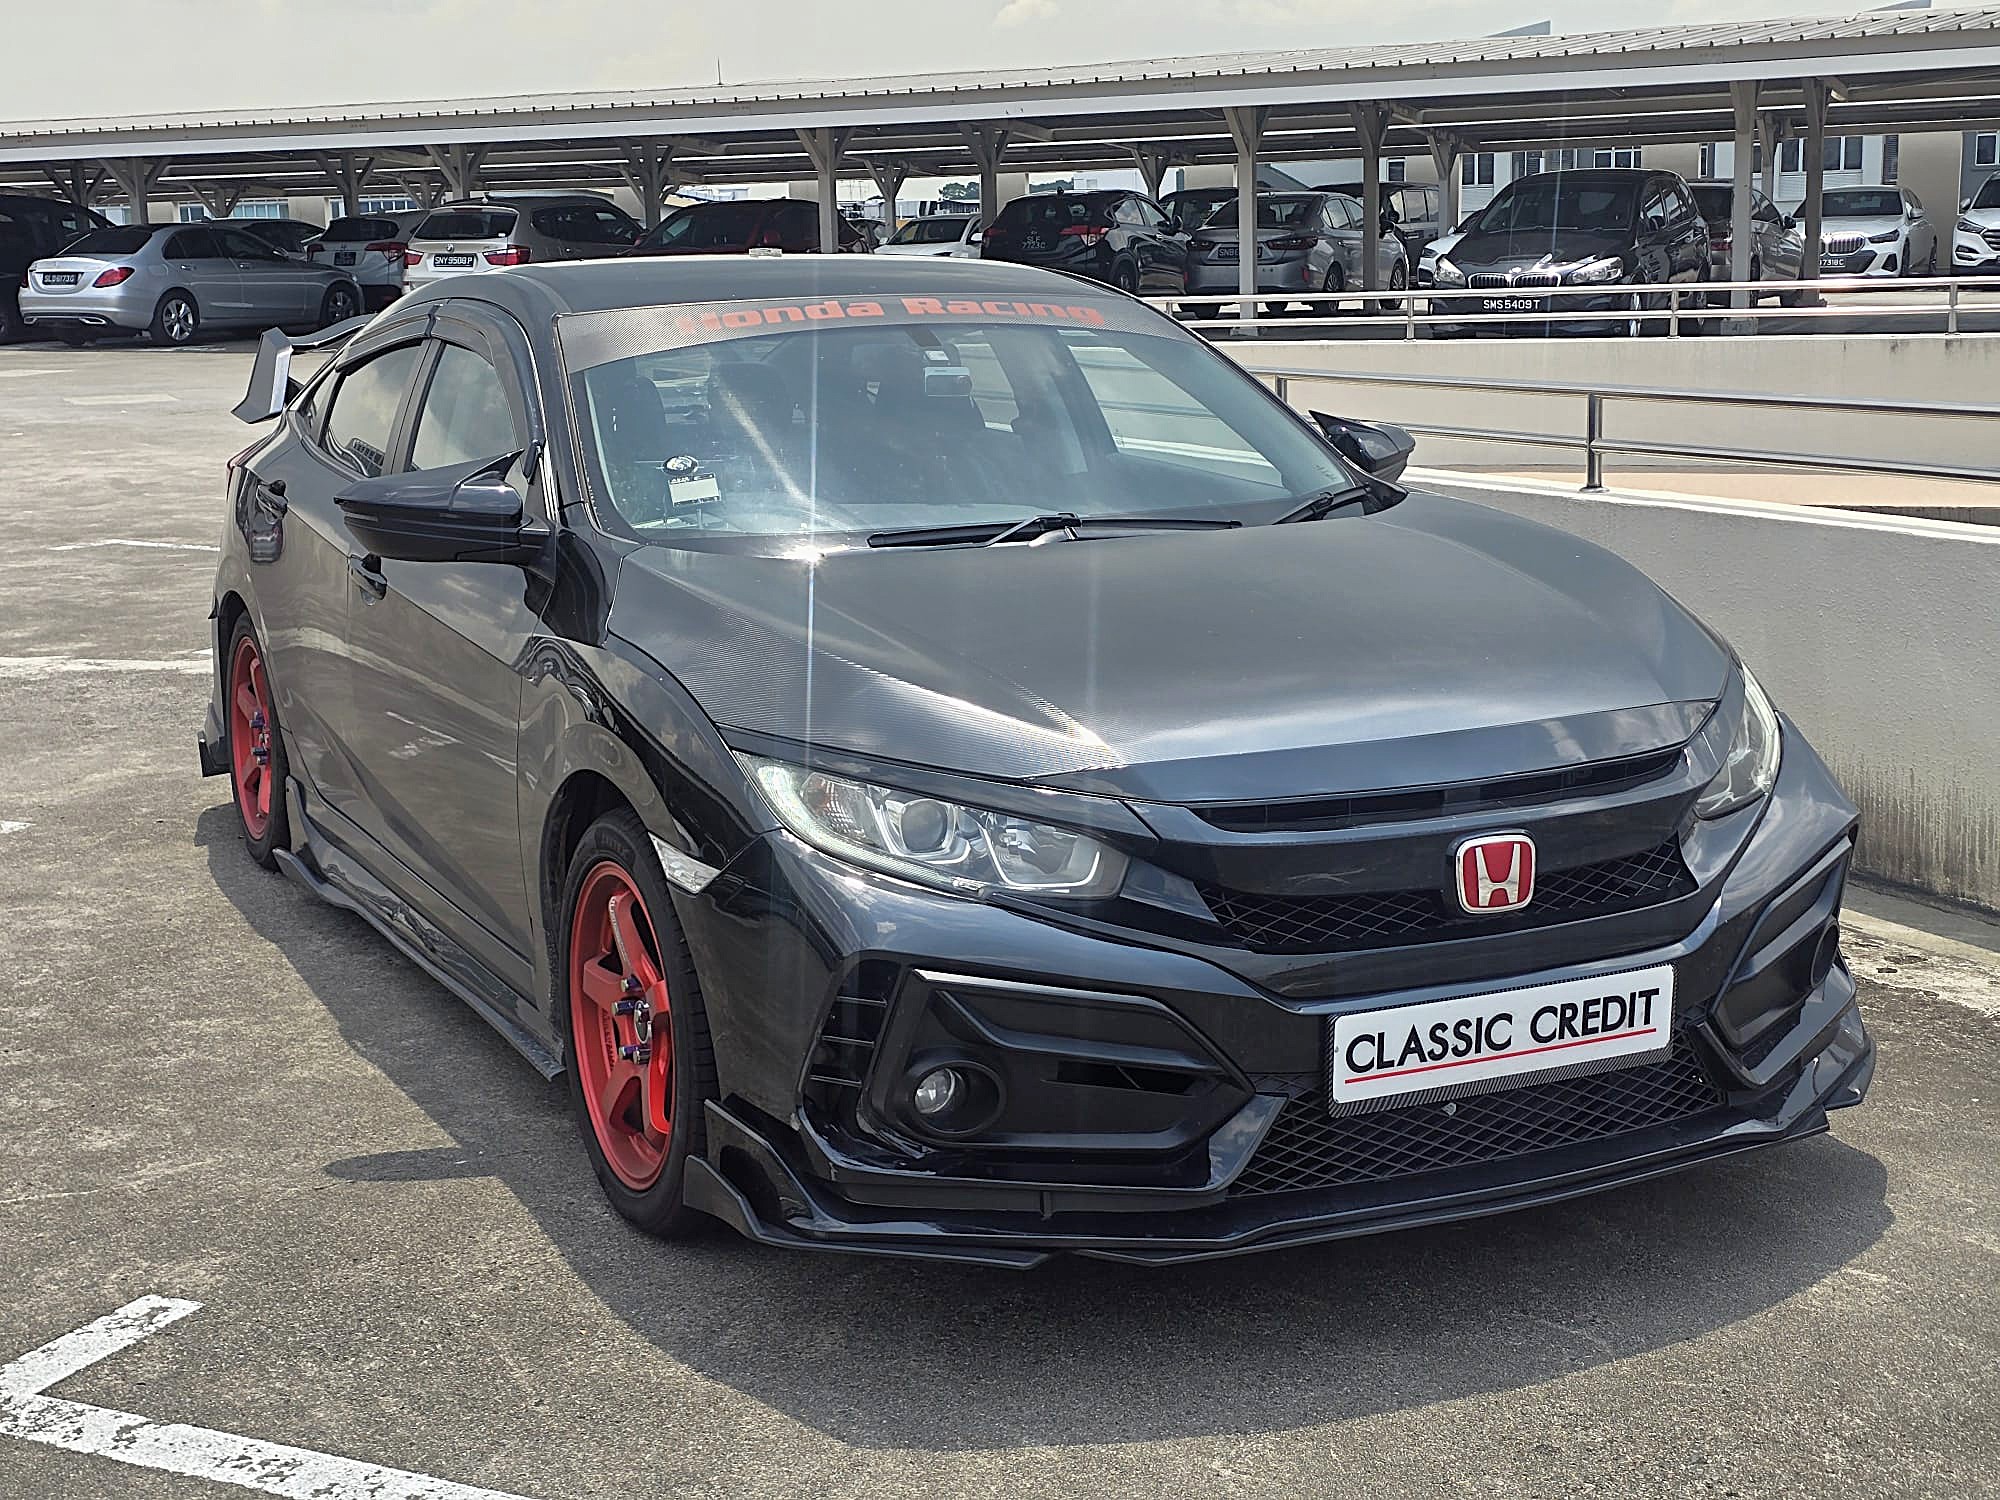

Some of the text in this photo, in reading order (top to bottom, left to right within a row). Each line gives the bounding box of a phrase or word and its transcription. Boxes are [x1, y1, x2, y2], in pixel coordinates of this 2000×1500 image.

[675, 297, 1105, 334] Honda Racing
[1483, 299, 1541, 310] SMS5409T
[1345, 988, 1660, 1074] CLASSIC CREDIT
